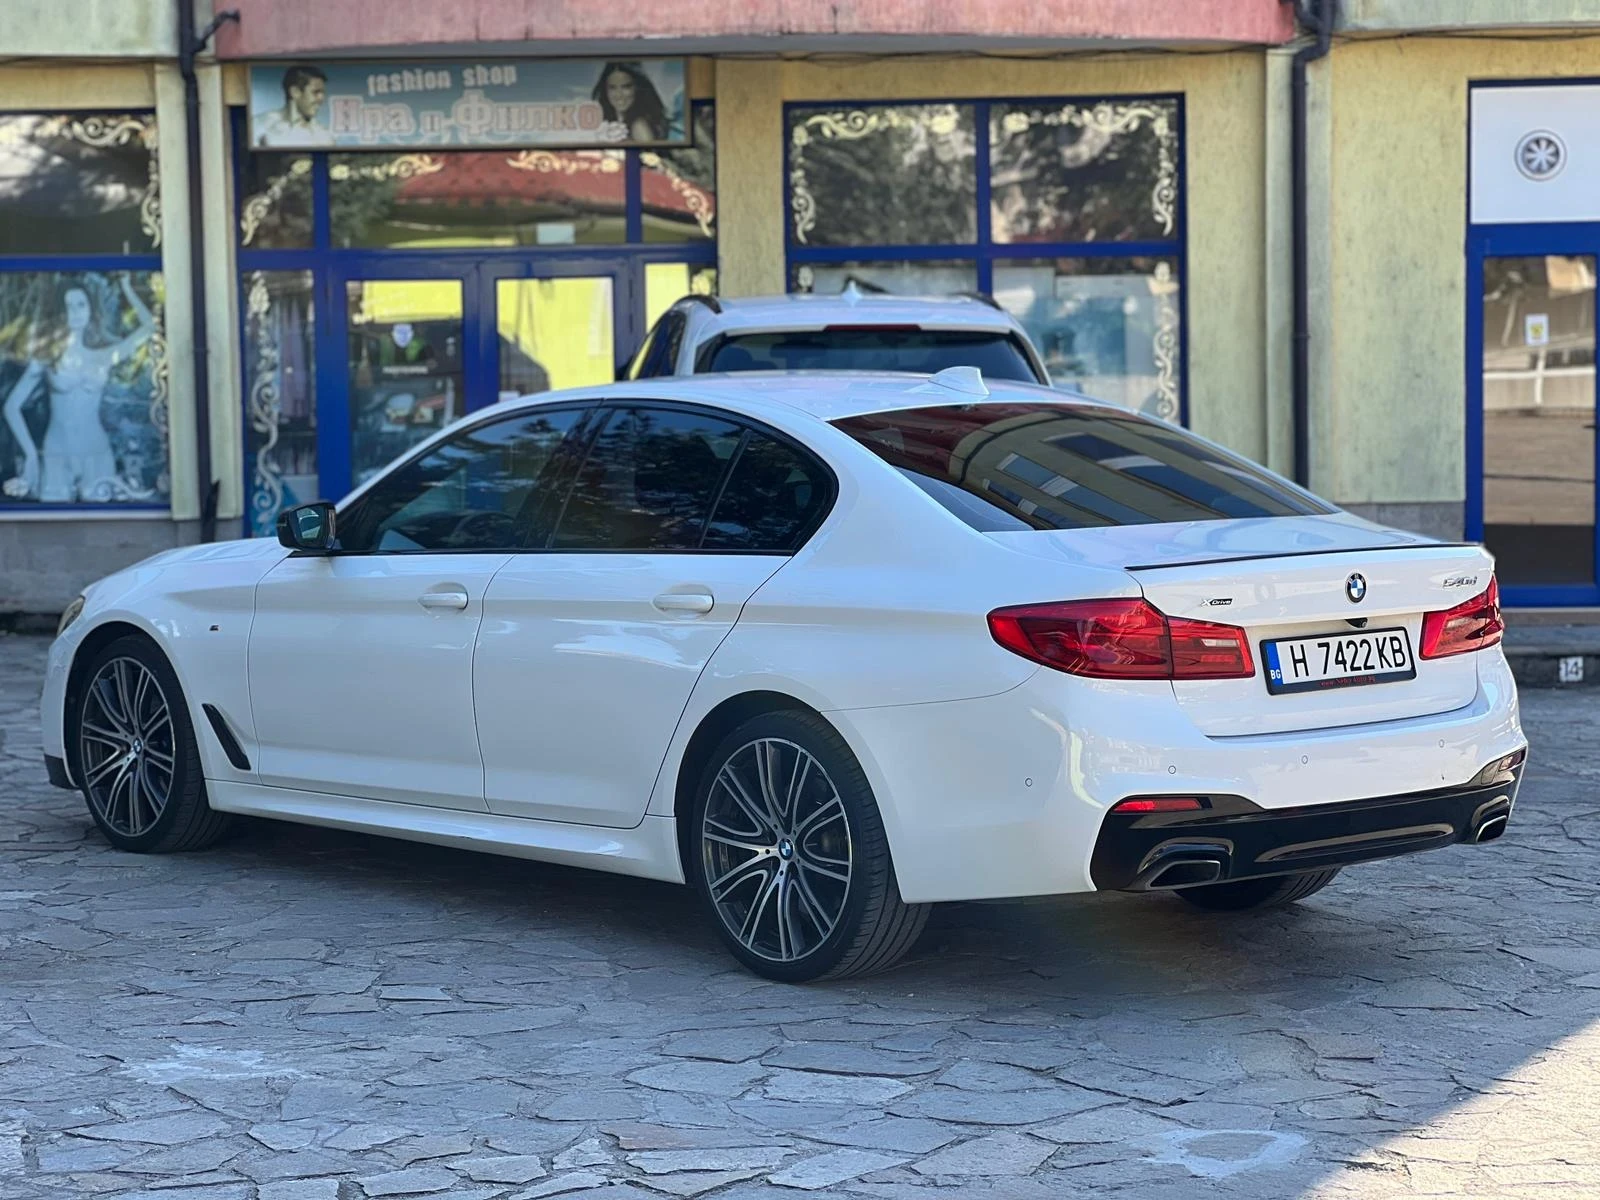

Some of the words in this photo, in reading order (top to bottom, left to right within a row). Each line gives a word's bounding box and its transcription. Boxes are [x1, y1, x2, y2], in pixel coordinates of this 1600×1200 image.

[367, 68, 451, 97] fashion
[462, 64, 516, 87] shop
[1270, 669, 1281, 680] BG
[1290, 644, 1309, 677] H
